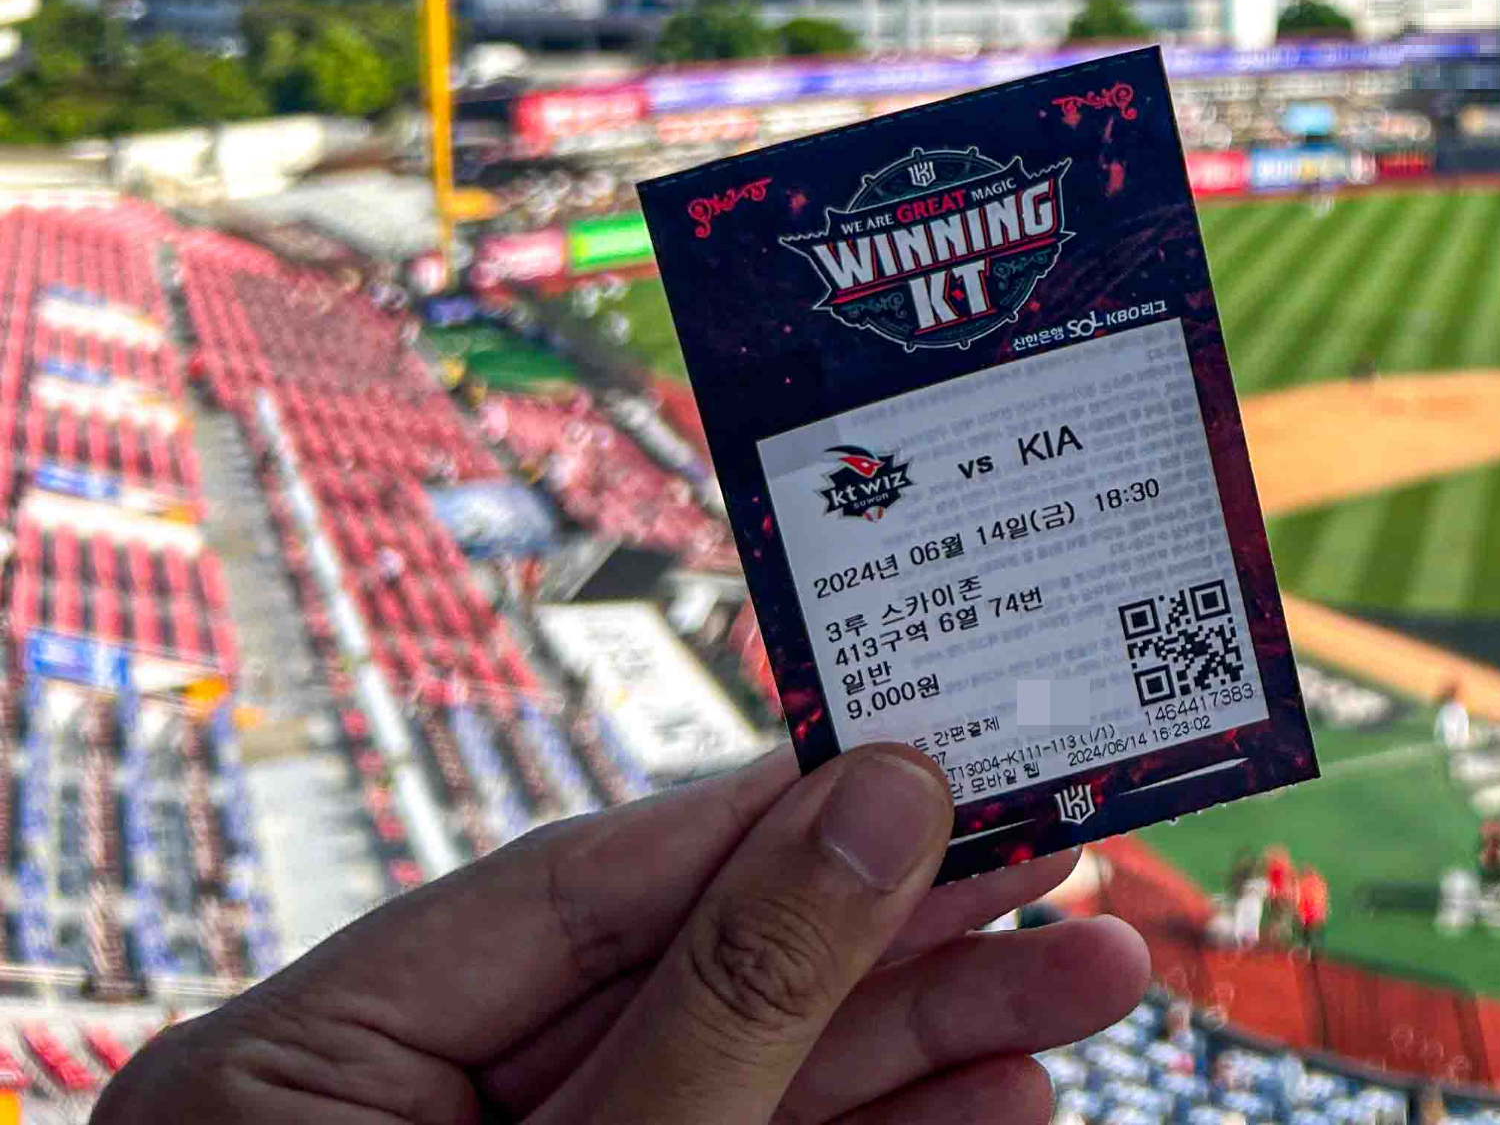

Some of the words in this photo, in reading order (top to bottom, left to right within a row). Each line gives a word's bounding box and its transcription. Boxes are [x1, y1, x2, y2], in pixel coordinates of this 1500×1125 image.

[840, 221, 863, 235] WE
[865, 213, 894, 230] ARE
[896, 189, 966, 224] GREAT
[971, 177, 1017, 203] MAGIC
[813, 177, 1058, 293] WINNING
[909, 257, 990, 331] KT
[1012, 326, 1065, 351] 신한은행
[957, 455, 994, 479] vs
[1017, 425, 1084, 466] KIA
[813, 553, 900, 600] 2024년
[909, 532, 965, 565] 06월
[976, 500, 1076, 546] 14일(금)
[1094, 477, 1160, 512] 18:30
[825, 613, 869, 644] 3루
[880, 574, 983, 626] 스카이존
[834, 619, 930, 667] 413구역
[938, 604, 980, 634] 6열
[988, 586, 1045, 618] 74번
[842, 660, 893, 696] 일반
[1144, 681, 1255, 727] 1464417383
[933, 715, 1001, 749] 간편결제
[1067, 732, 1148, 767] 2024/06/14
[1152, 715, 1212, 743] 16:23:02
[971, 768, 1018, 794] 모바일
